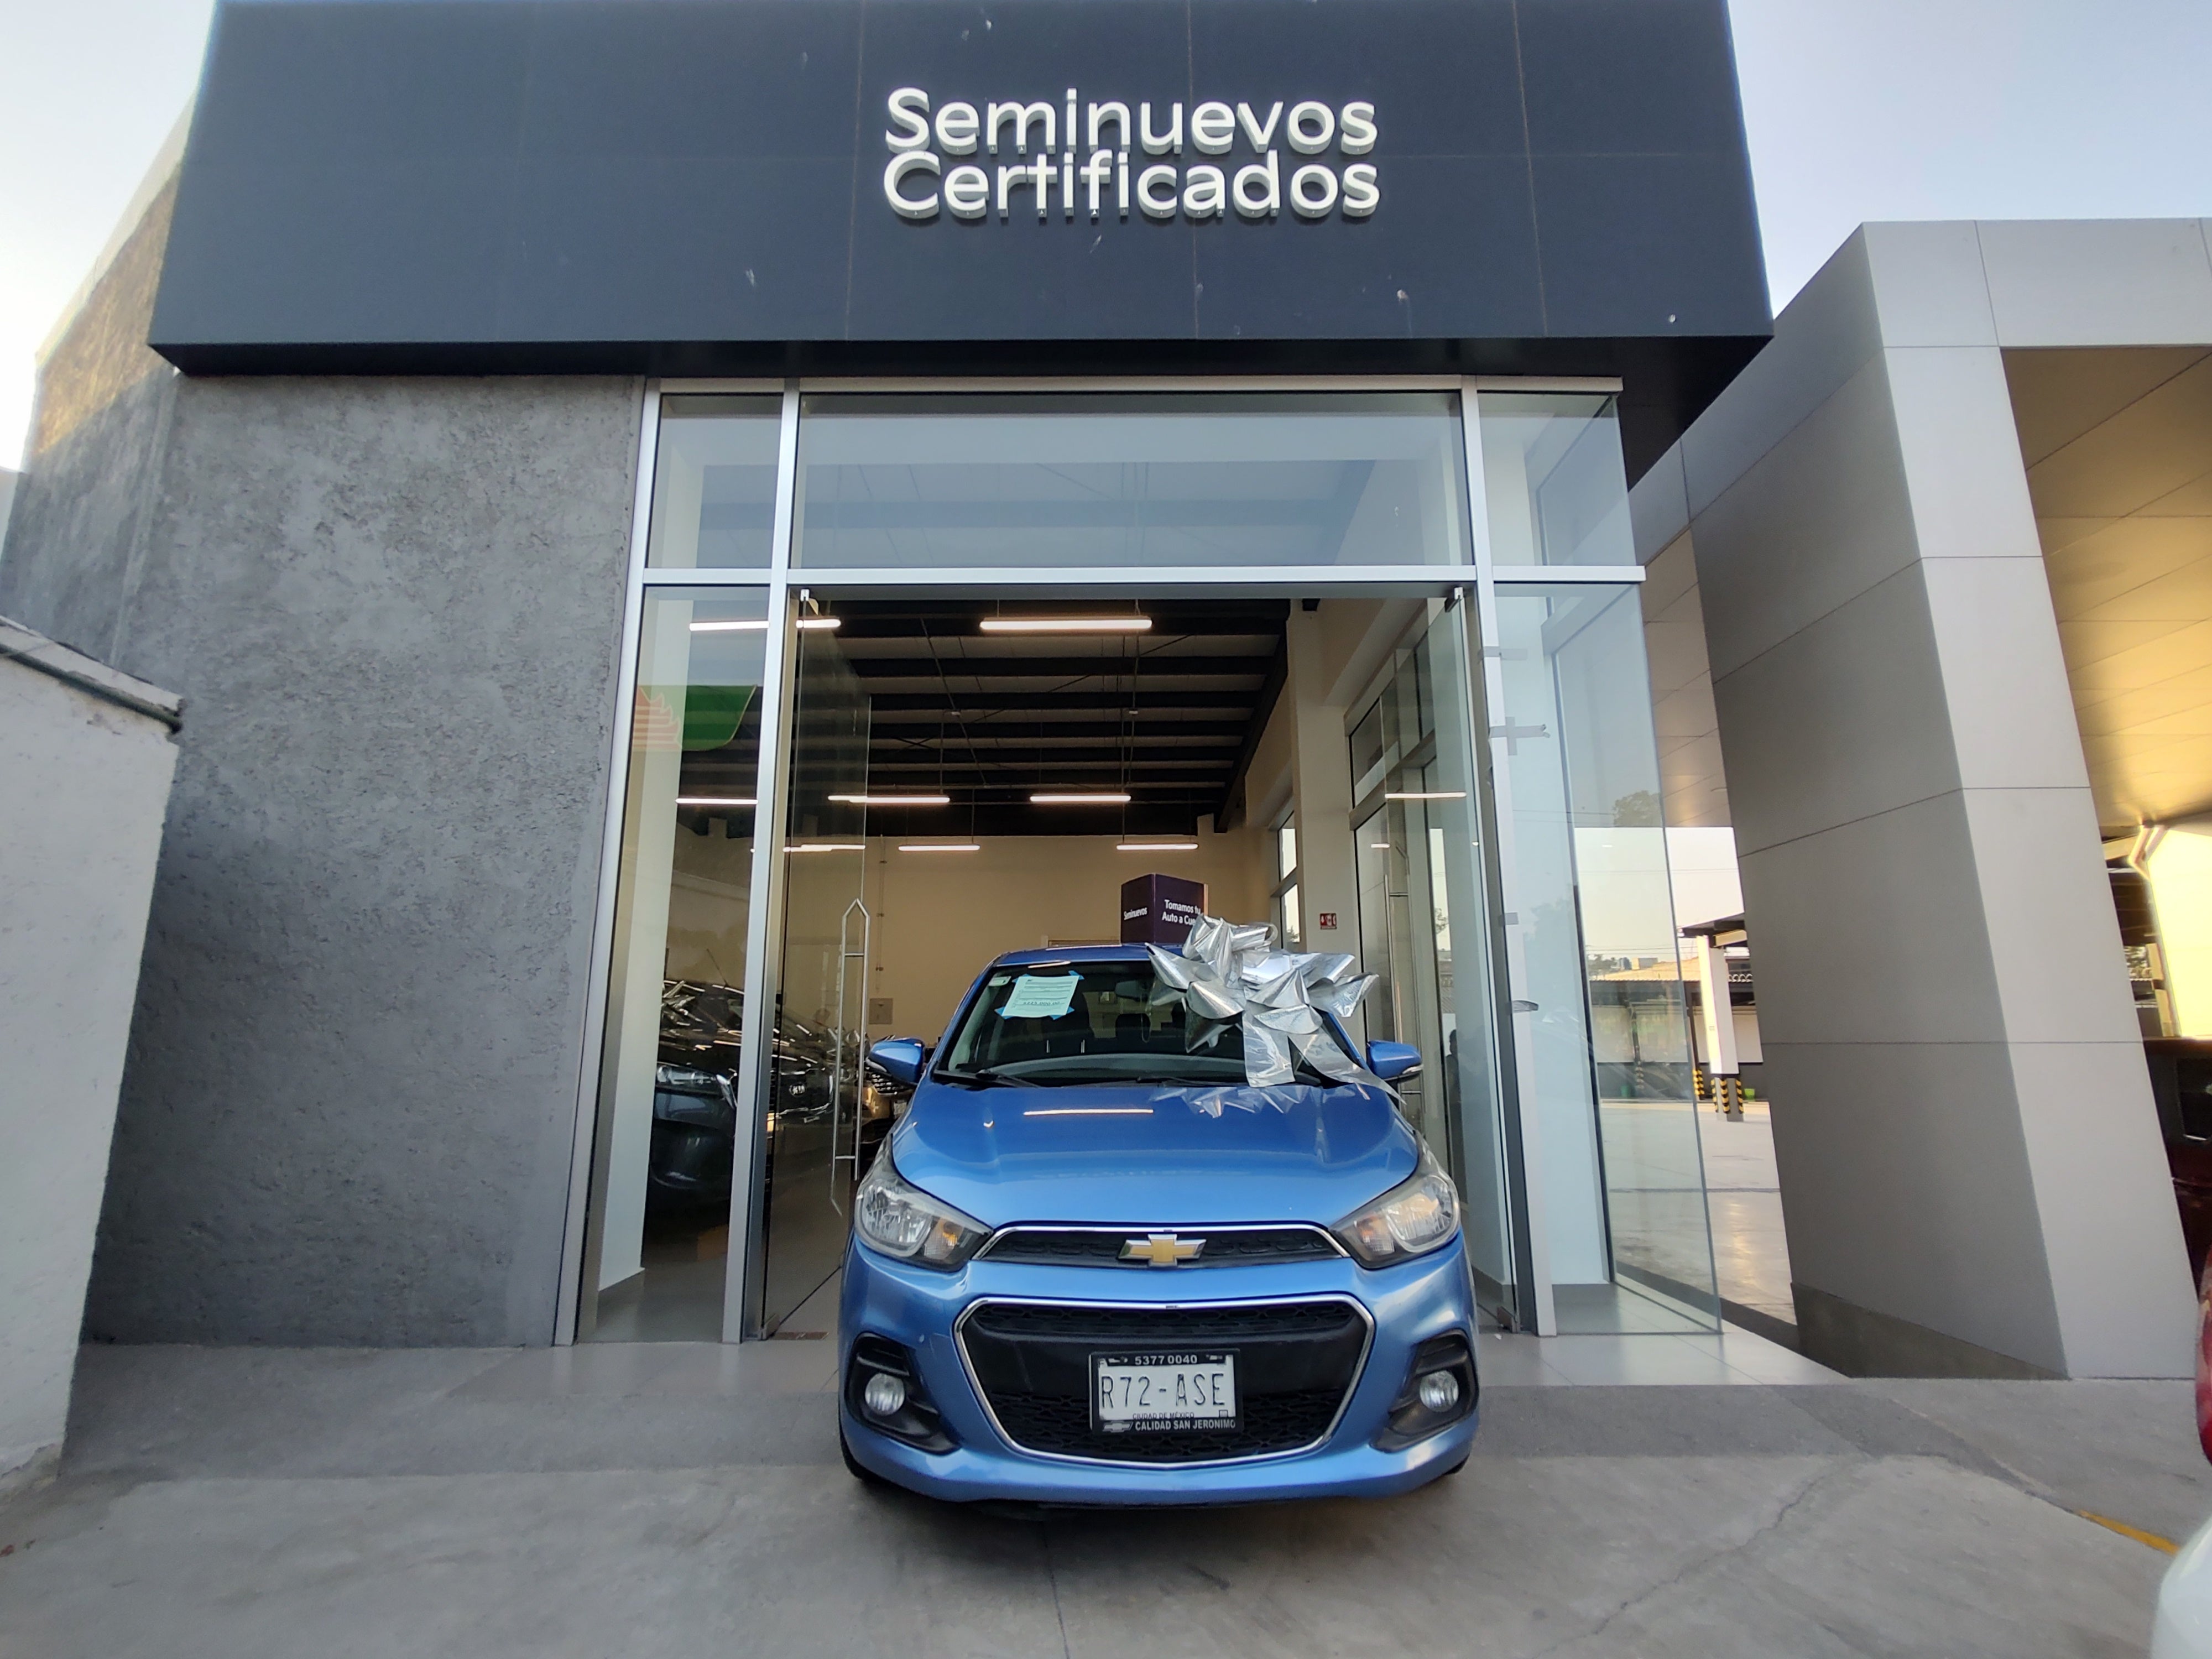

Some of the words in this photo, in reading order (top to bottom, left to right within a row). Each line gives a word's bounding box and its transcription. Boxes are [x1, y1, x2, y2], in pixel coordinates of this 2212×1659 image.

[885, 88, 1378, 155] Seminuevos
[884, 149, 1380, 219] Certificados
[1164, 899, 1194, 914] Tomamos
[1194, 905, 1201, 915] tu
[1162, 911, 1178, 923] Auto
[1184, 915, 1196, 926] Cue
[1134, 1355, 1165, 1365] 5377
[1167, 1354, 1198, 1364] 0040
[1101, 1373, 1225, 1408] R72-ASE
[1170, 1411, 1194, 1420] MÉXICO
[1135, 1421, 1171, 1431] CALIDAD
[1173, 1420, 1191, 1430] SAN
[1192, 1419, 1236, 1430] JERONIMO
